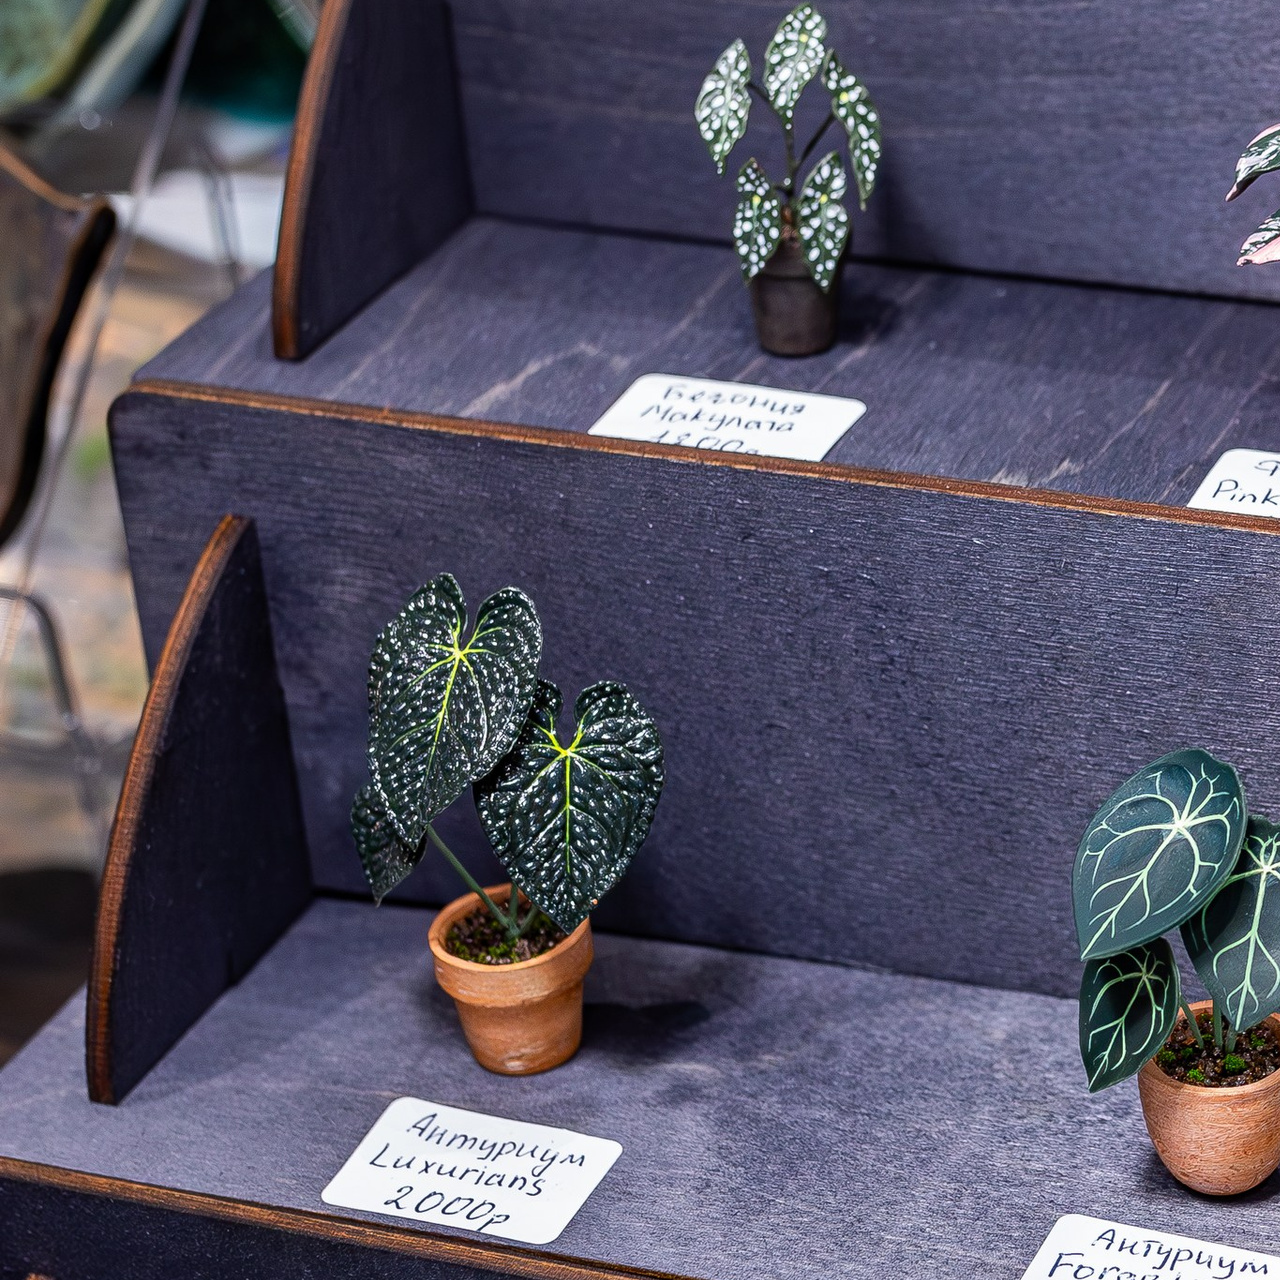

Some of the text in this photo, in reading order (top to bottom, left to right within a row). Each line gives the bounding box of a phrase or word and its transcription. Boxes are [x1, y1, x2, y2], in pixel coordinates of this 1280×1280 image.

[369, 1142, 546, 1197] Luxurians
[406, 1112, 586, 1176] Антуриум
[383, 1185, 511, 1232] 2000р
[1091, 1228, 1269, 1280] Антуриум
